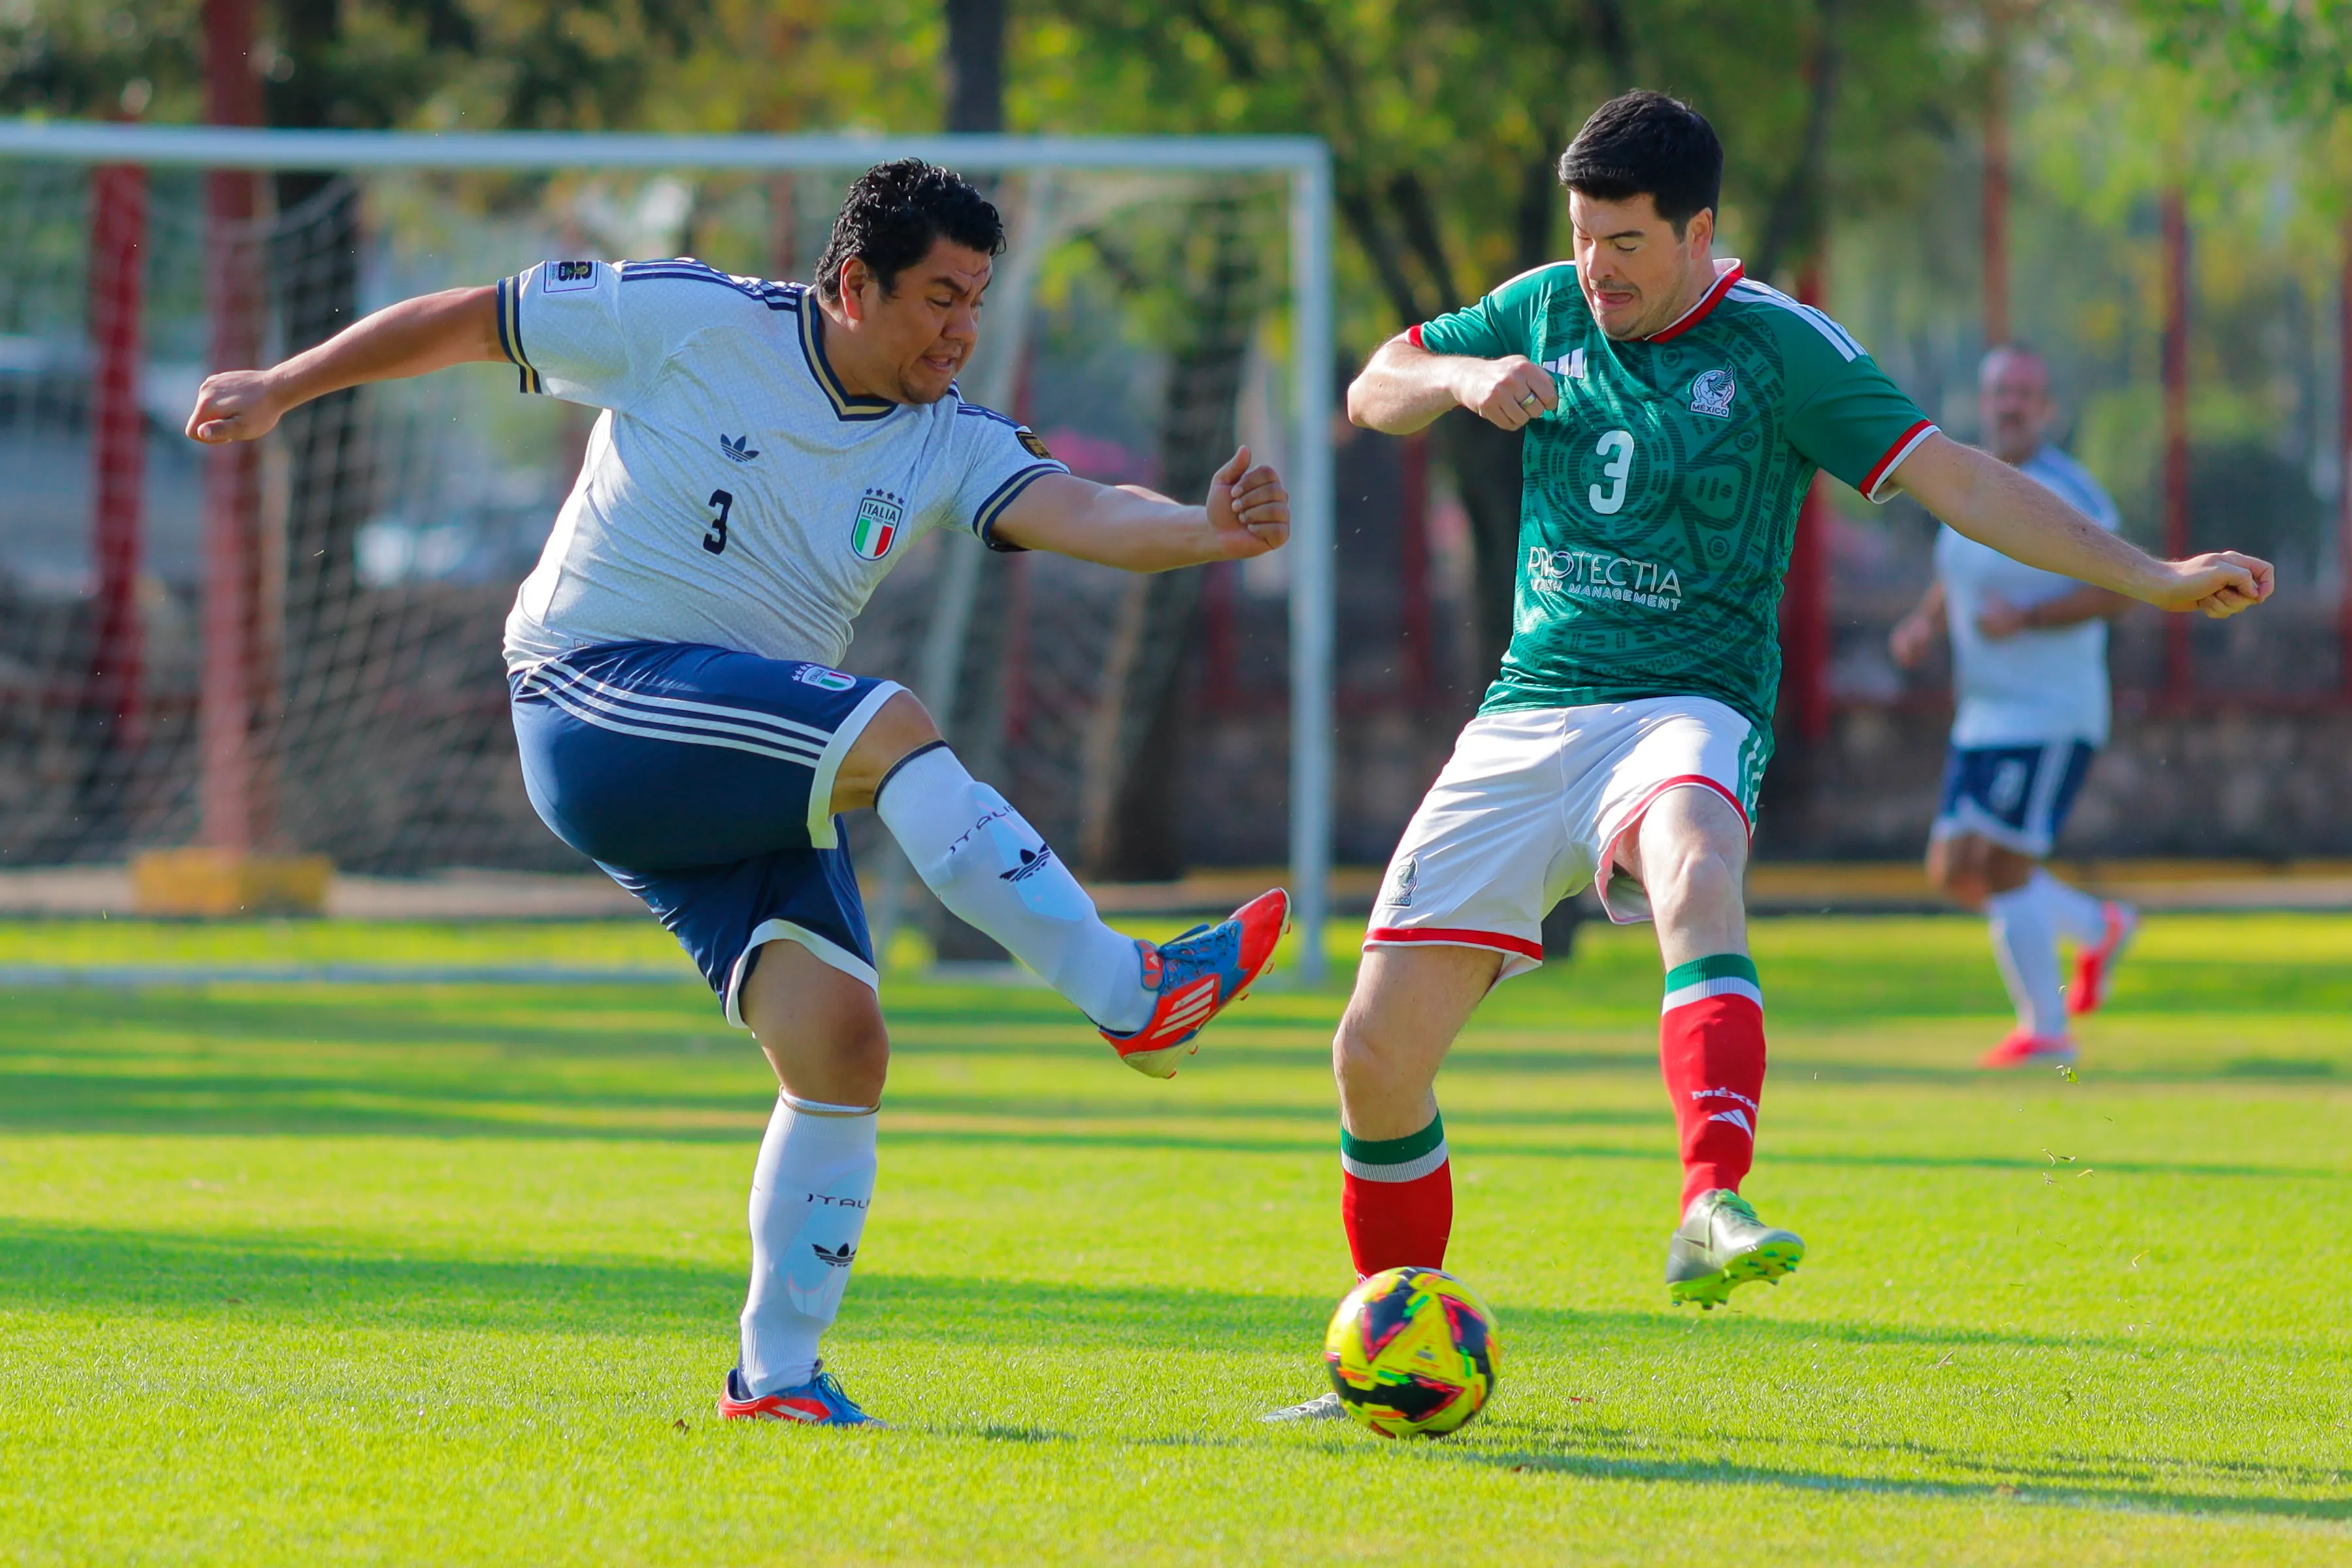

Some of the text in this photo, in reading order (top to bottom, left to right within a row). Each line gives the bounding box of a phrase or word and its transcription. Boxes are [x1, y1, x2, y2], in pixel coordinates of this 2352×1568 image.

[1589, 430, 1634, 514] 3
[703, 489, 733, 555] 3
[862, 502, 897, 522] ITALIA
[1527, 546, 1681, 597] PROTECTIA
[1568, 583, 1680, 611] MANAGEMENT
